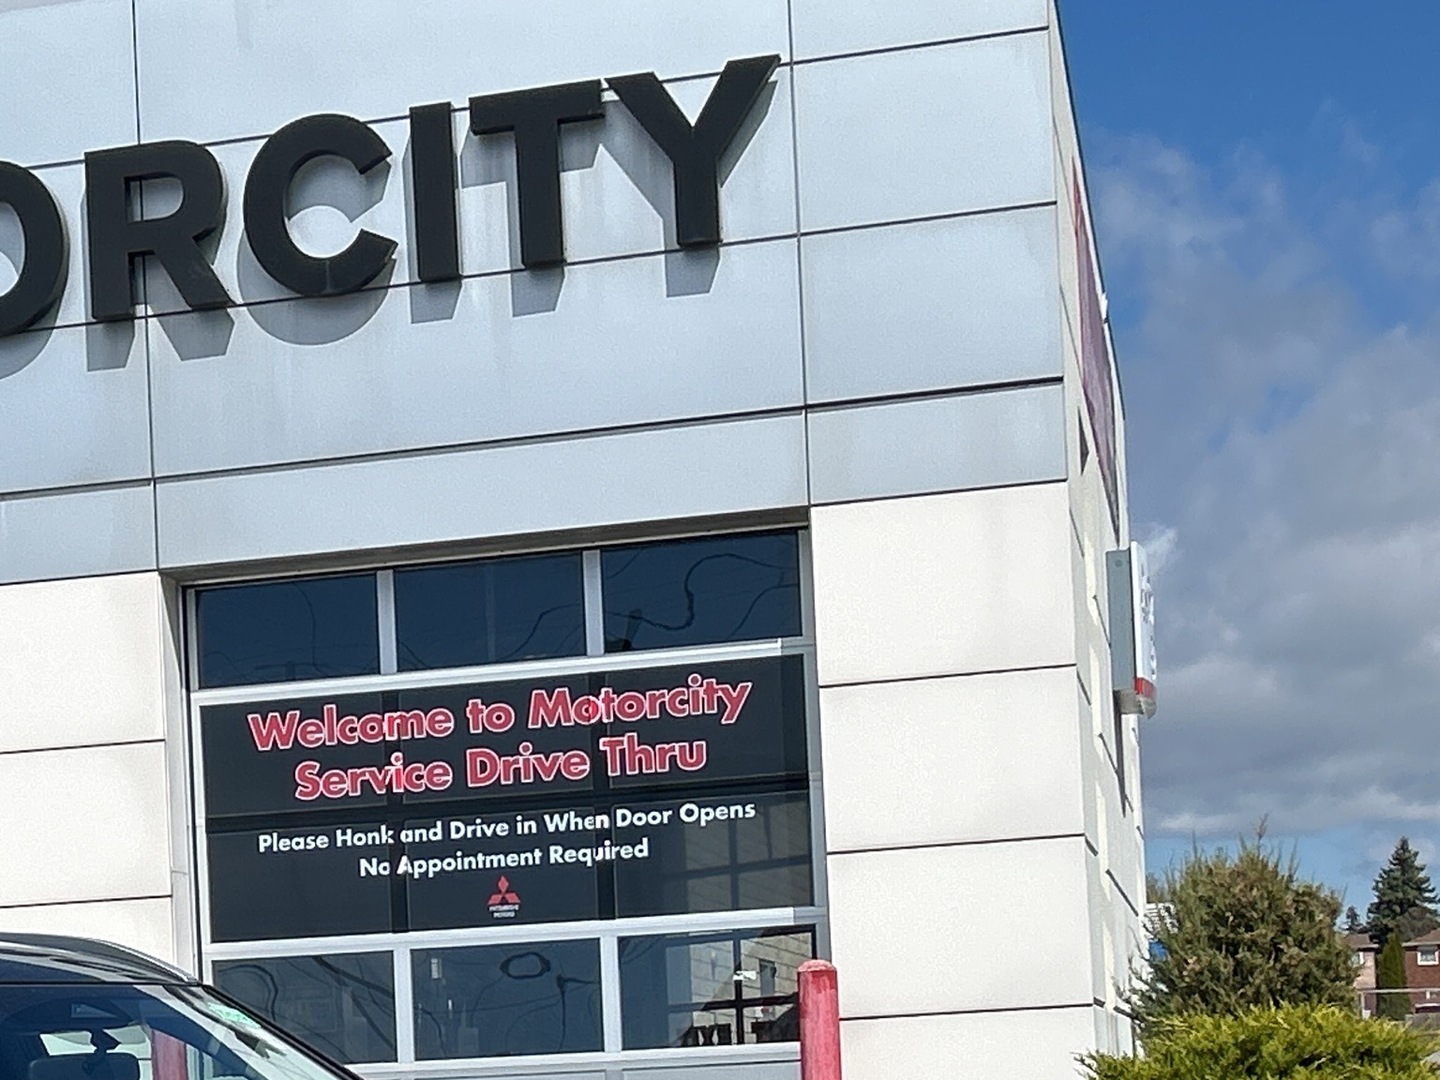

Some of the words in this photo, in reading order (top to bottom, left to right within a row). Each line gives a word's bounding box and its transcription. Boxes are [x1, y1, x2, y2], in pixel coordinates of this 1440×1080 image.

[247, 703, 454, 750] Welcome
[466, 699, 515, 734] to
[528, 673, 752, 730] Motorcity
[294, 753, 453, 801] Service
[466, 742, 590, 788] Drive
[599, 732, 707, 777] Thru
[258, 831, 330, 854] Please
[336, 823, 396, 849] Honk
[400, 819, 442, 844] and
[450, 815, 509, 840] Drive
[516, 812, 538, 835] in
[543, 808, 610, 833] When
[616, 805, 671, 829] Door
[679, 801, 756, 829] Opens
[359, 857, 391, 877] No
[397, 848, 543, 880] Appointment
[549, 838, 649, 867] Required
